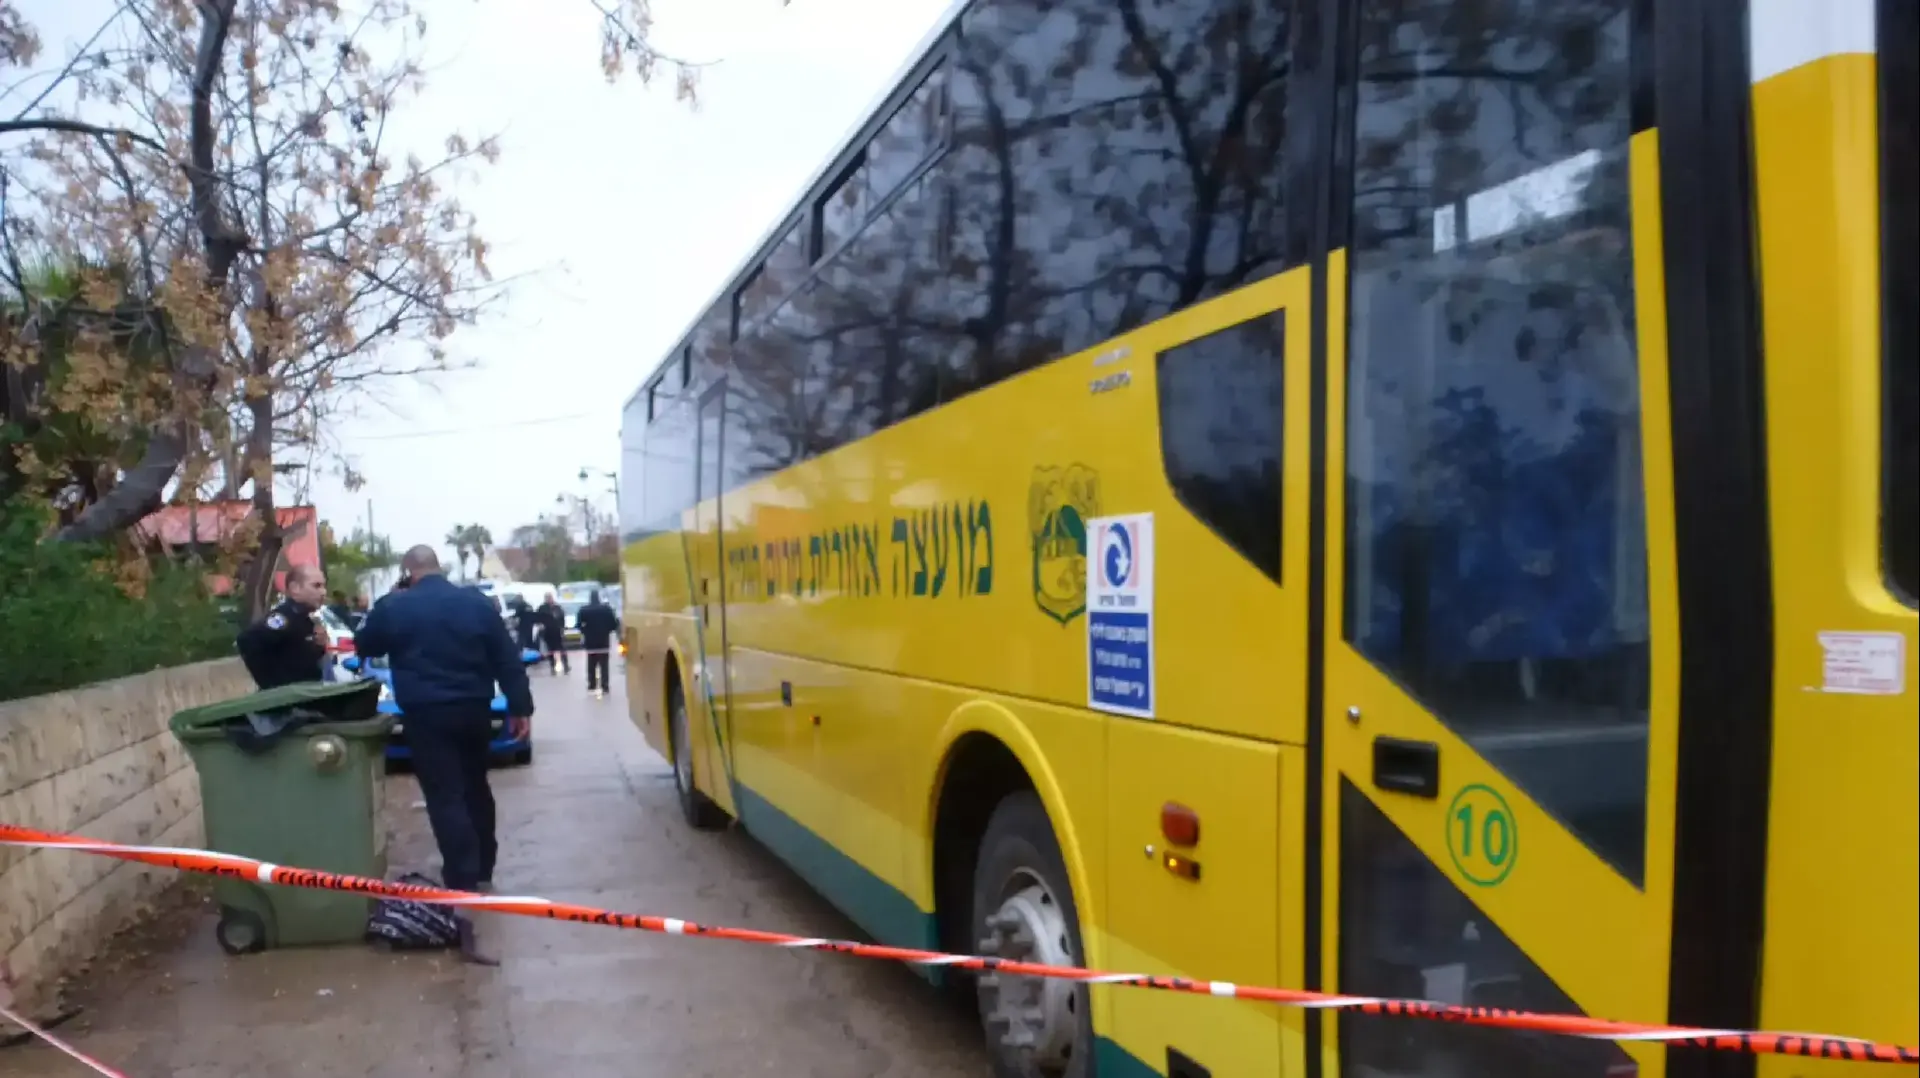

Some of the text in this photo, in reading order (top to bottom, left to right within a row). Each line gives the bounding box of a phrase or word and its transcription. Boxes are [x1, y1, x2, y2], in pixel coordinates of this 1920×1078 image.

[809, 518, 880, 599] אזורית
[891, 497, 993, 599] מועצה
[1456, 803, 1510, 867] 10
